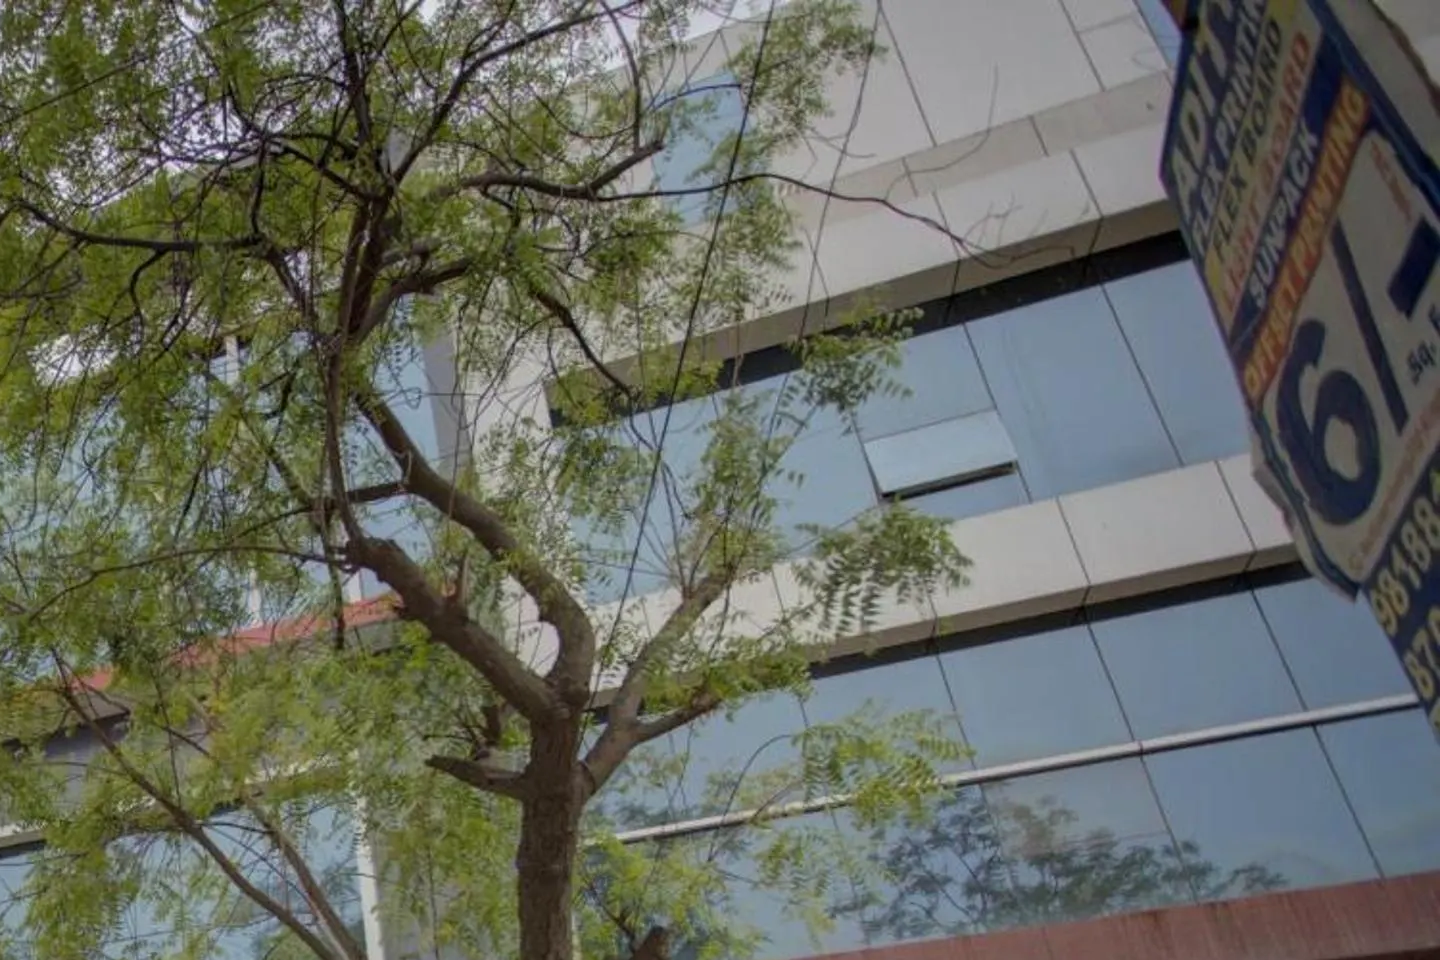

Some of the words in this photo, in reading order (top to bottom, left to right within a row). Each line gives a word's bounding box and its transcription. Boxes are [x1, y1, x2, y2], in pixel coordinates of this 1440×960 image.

[1169, 0, 1235, 226] ADIT
[1191, 155, 1227, 259] FLEX
[1210, 161, 1248, 264] FLEX
[1240, 20, 1281, 168] BOARD
[1247, 115, 1319, 313] SUNPACK
[1243, 260, 1303, 404] OFFSET
[1289, 80, 1366, 283] PRINTING
